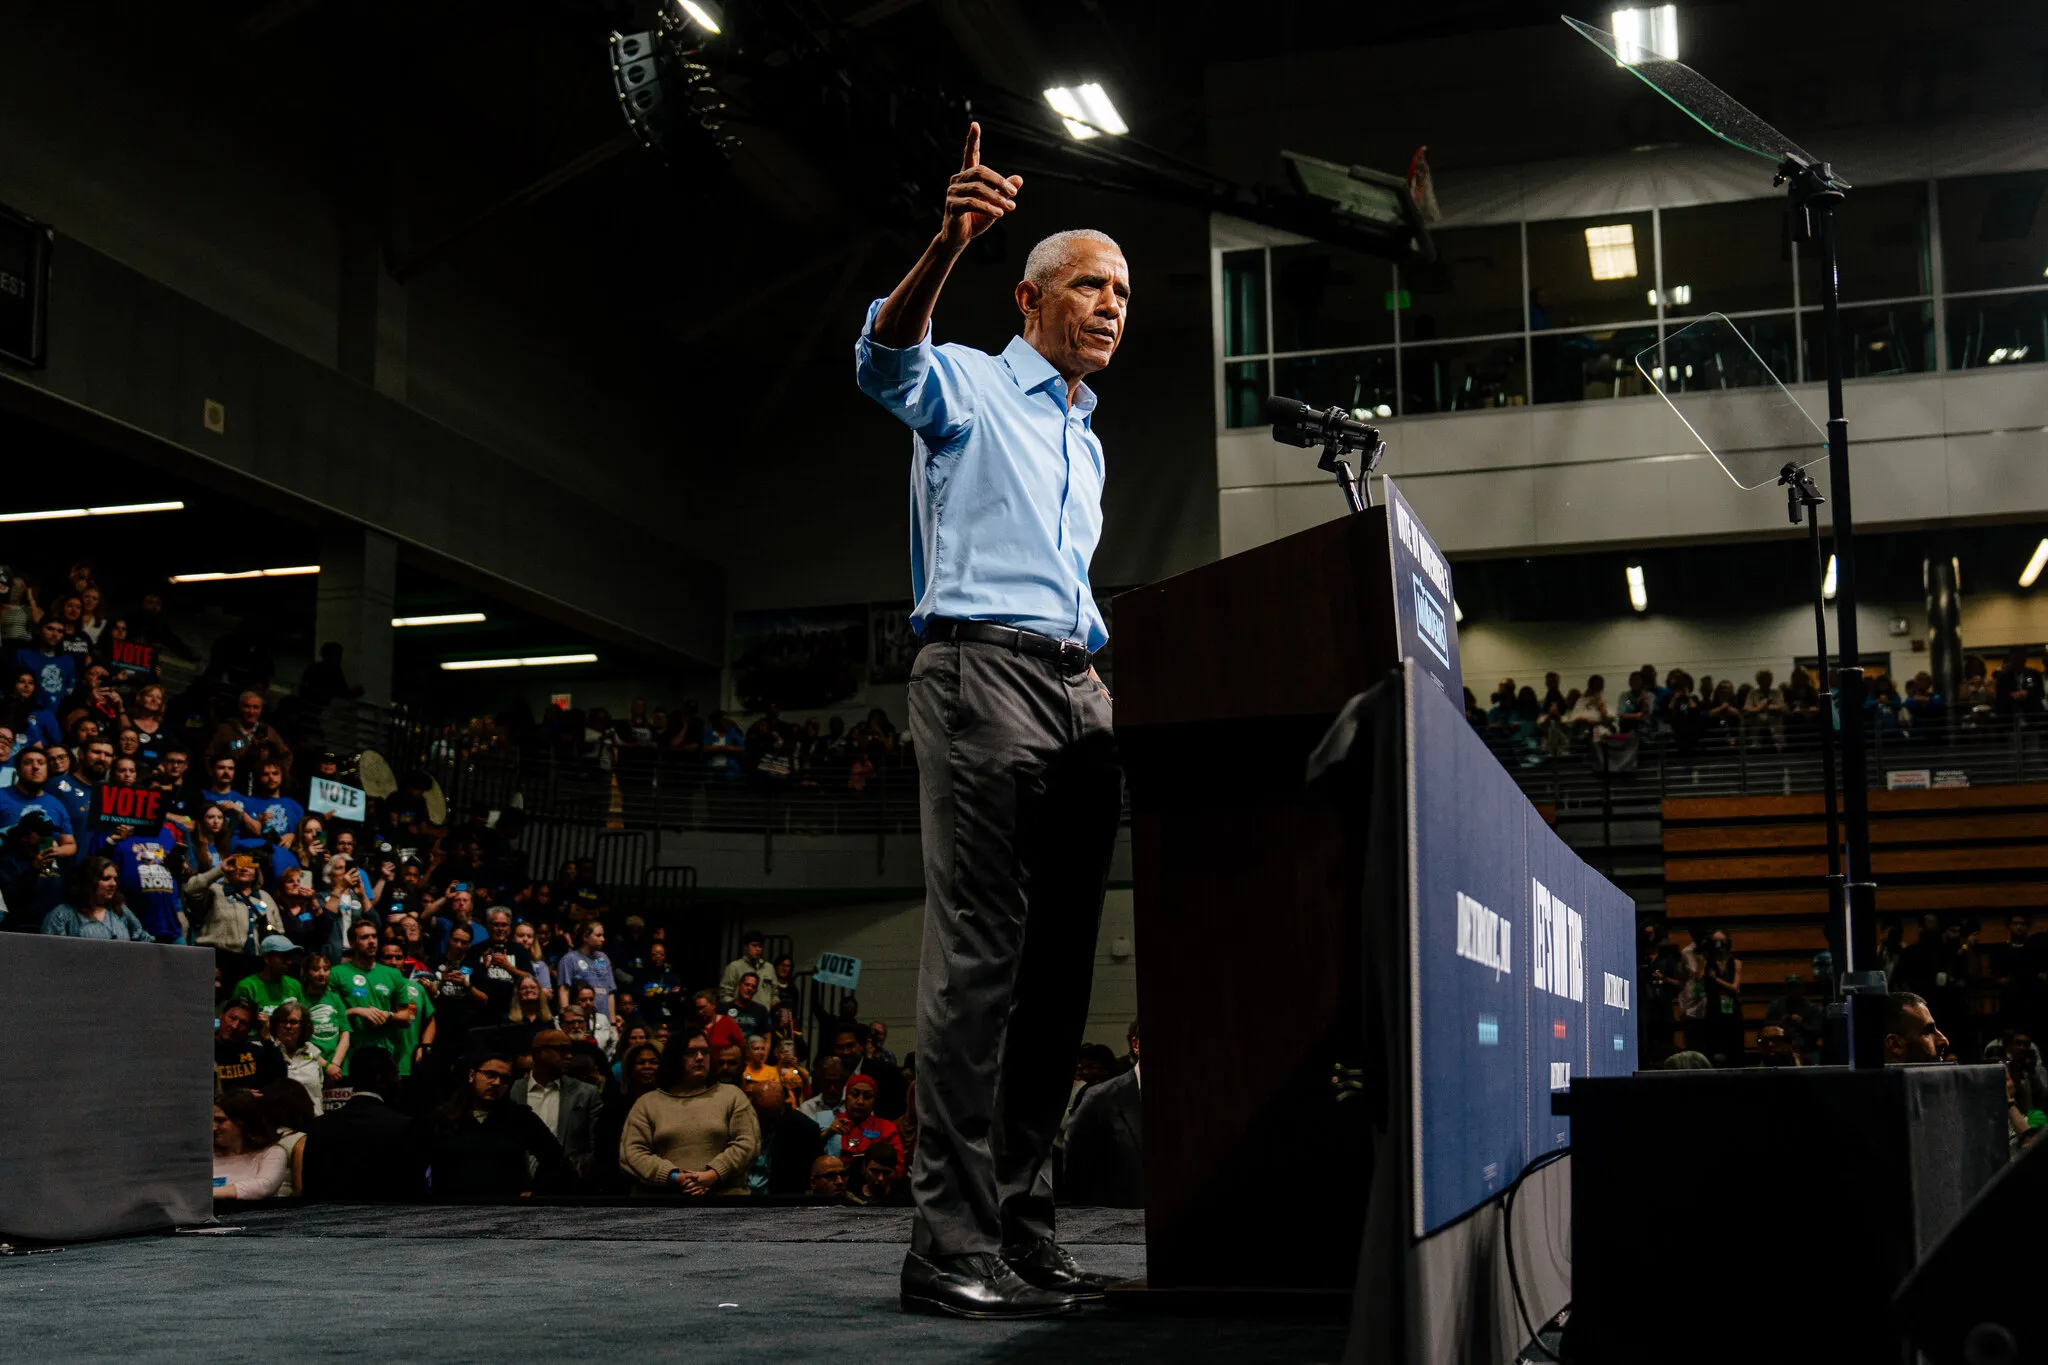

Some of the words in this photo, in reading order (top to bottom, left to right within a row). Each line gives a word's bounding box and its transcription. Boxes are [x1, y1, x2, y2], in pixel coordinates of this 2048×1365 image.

[112, 640, 153, 668] VOTE
[101, 784, 161, 820] VOTE
[319, 779, 358, 808] VOTE
[821, 953, 856, 977] VOTE
